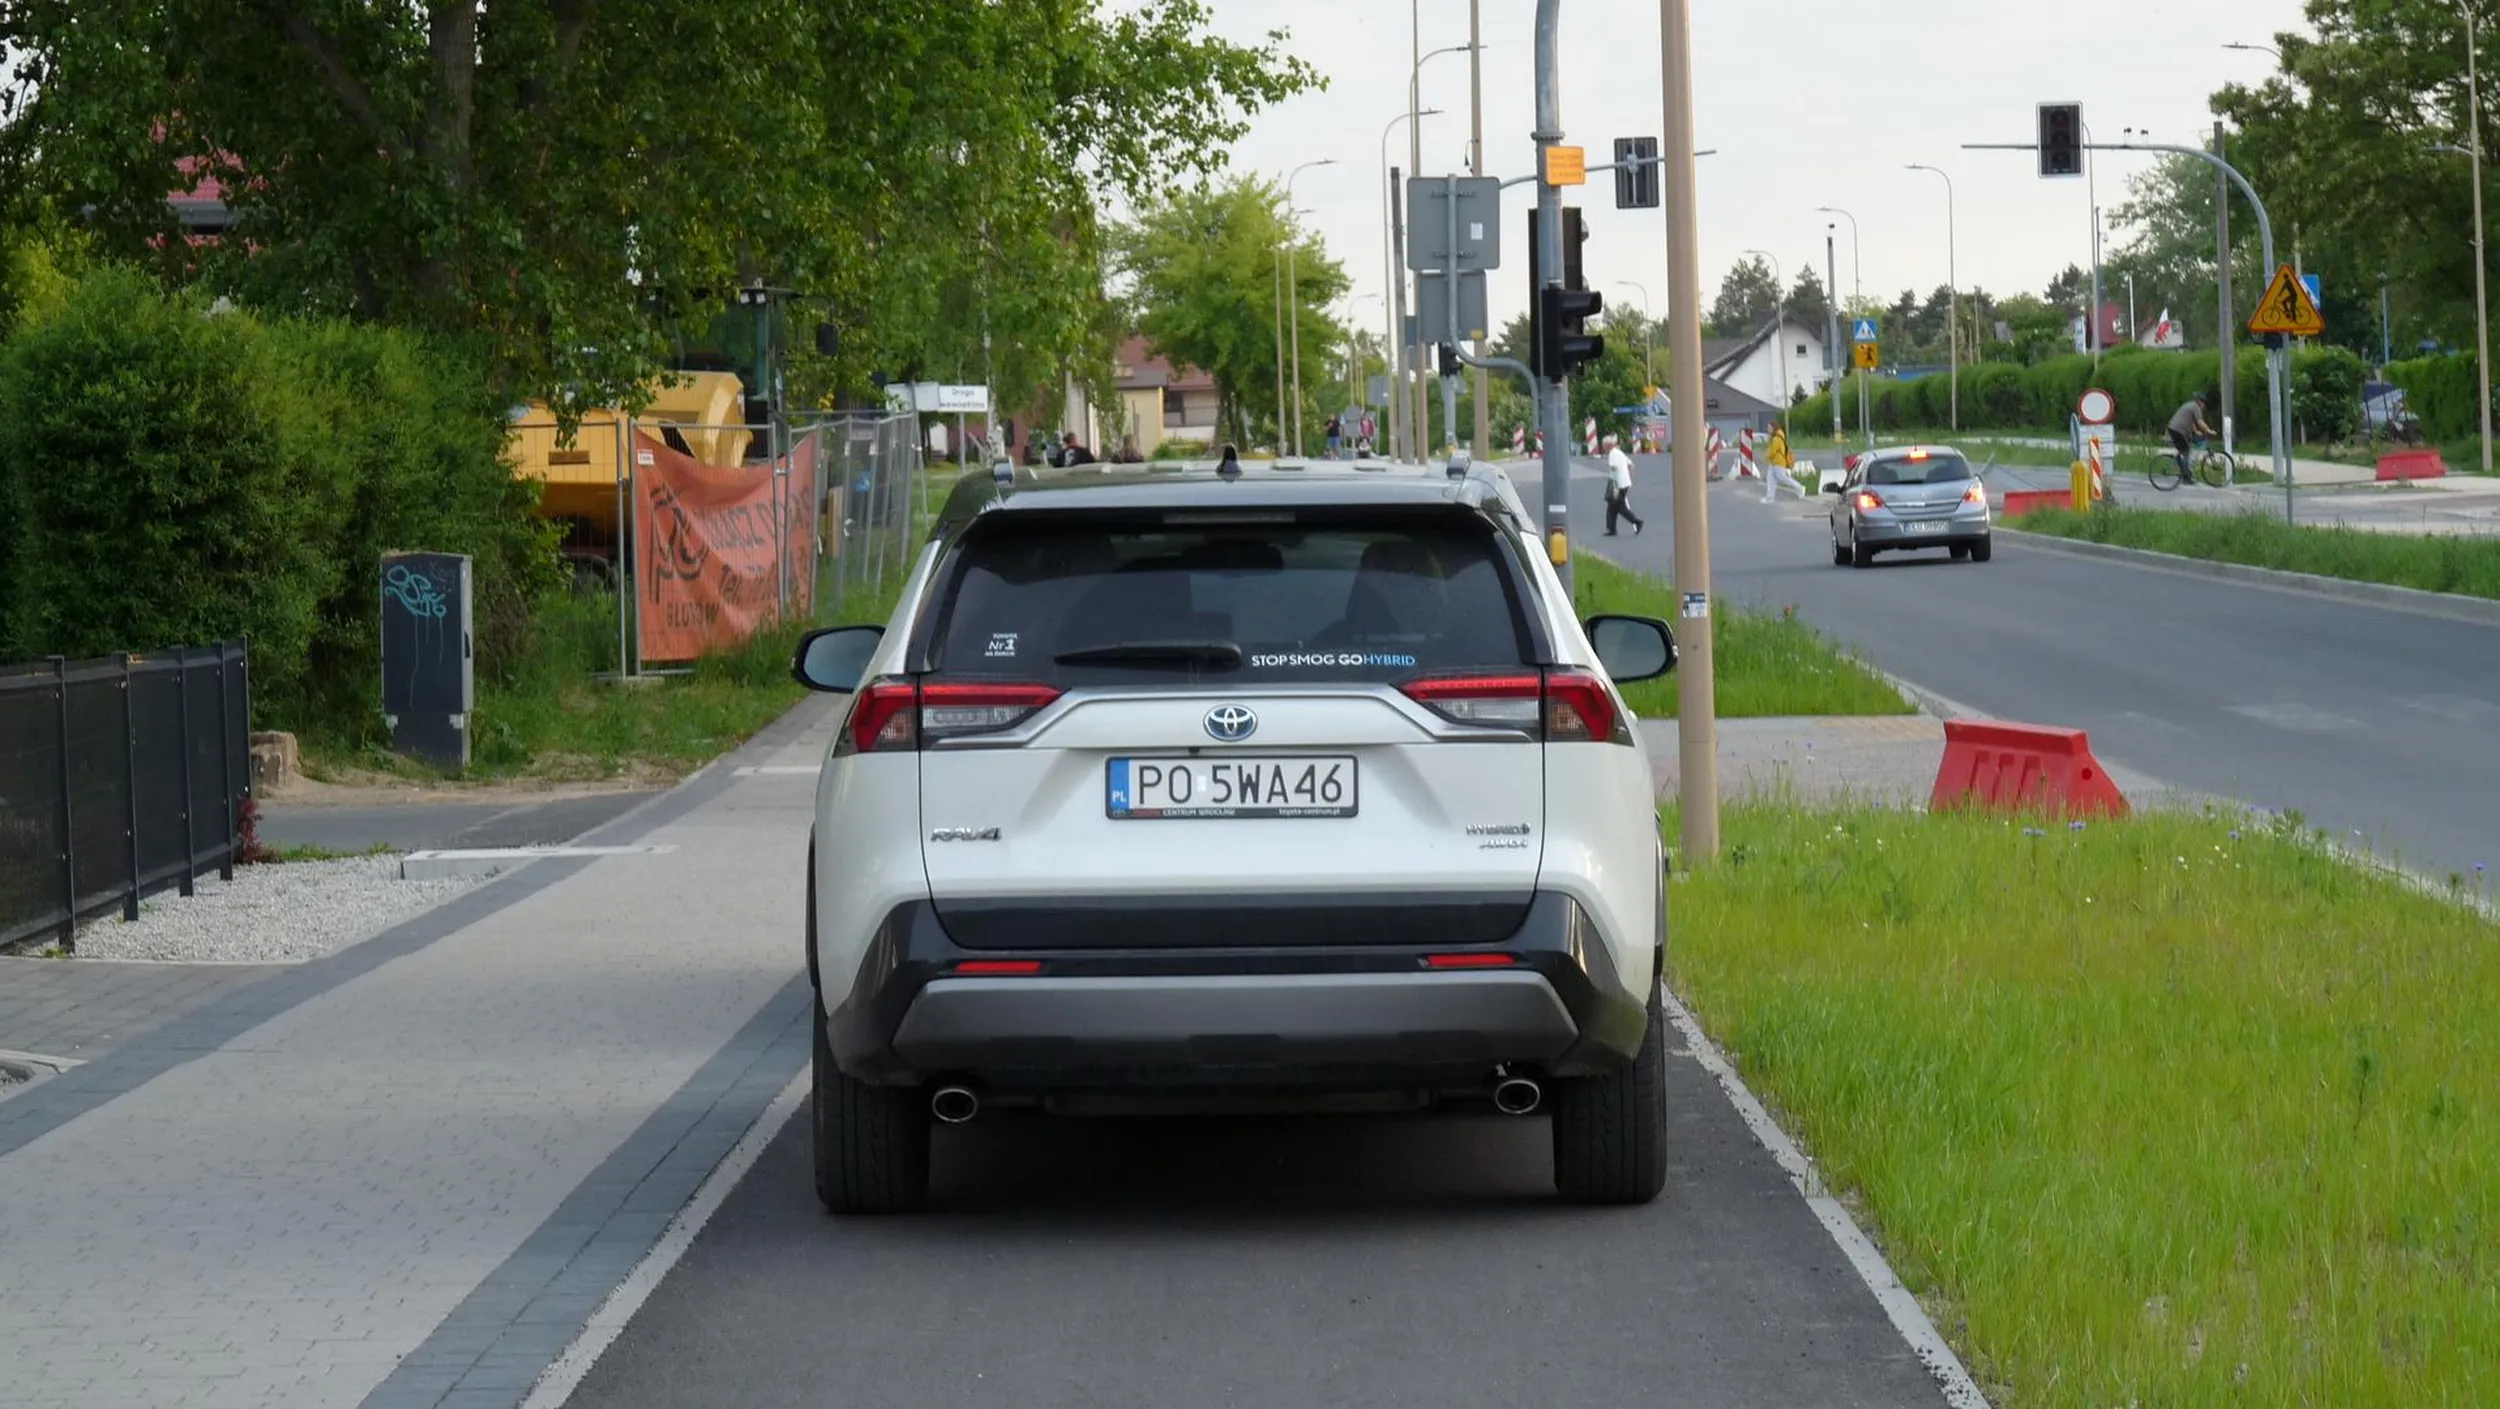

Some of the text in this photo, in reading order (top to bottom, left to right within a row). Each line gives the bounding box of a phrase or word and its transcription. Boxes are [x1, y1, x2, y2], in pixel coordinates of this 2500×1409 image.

[1112, 791, 1127, 802] PL
[1139, 764, 1342, 804] PO 5WA46
